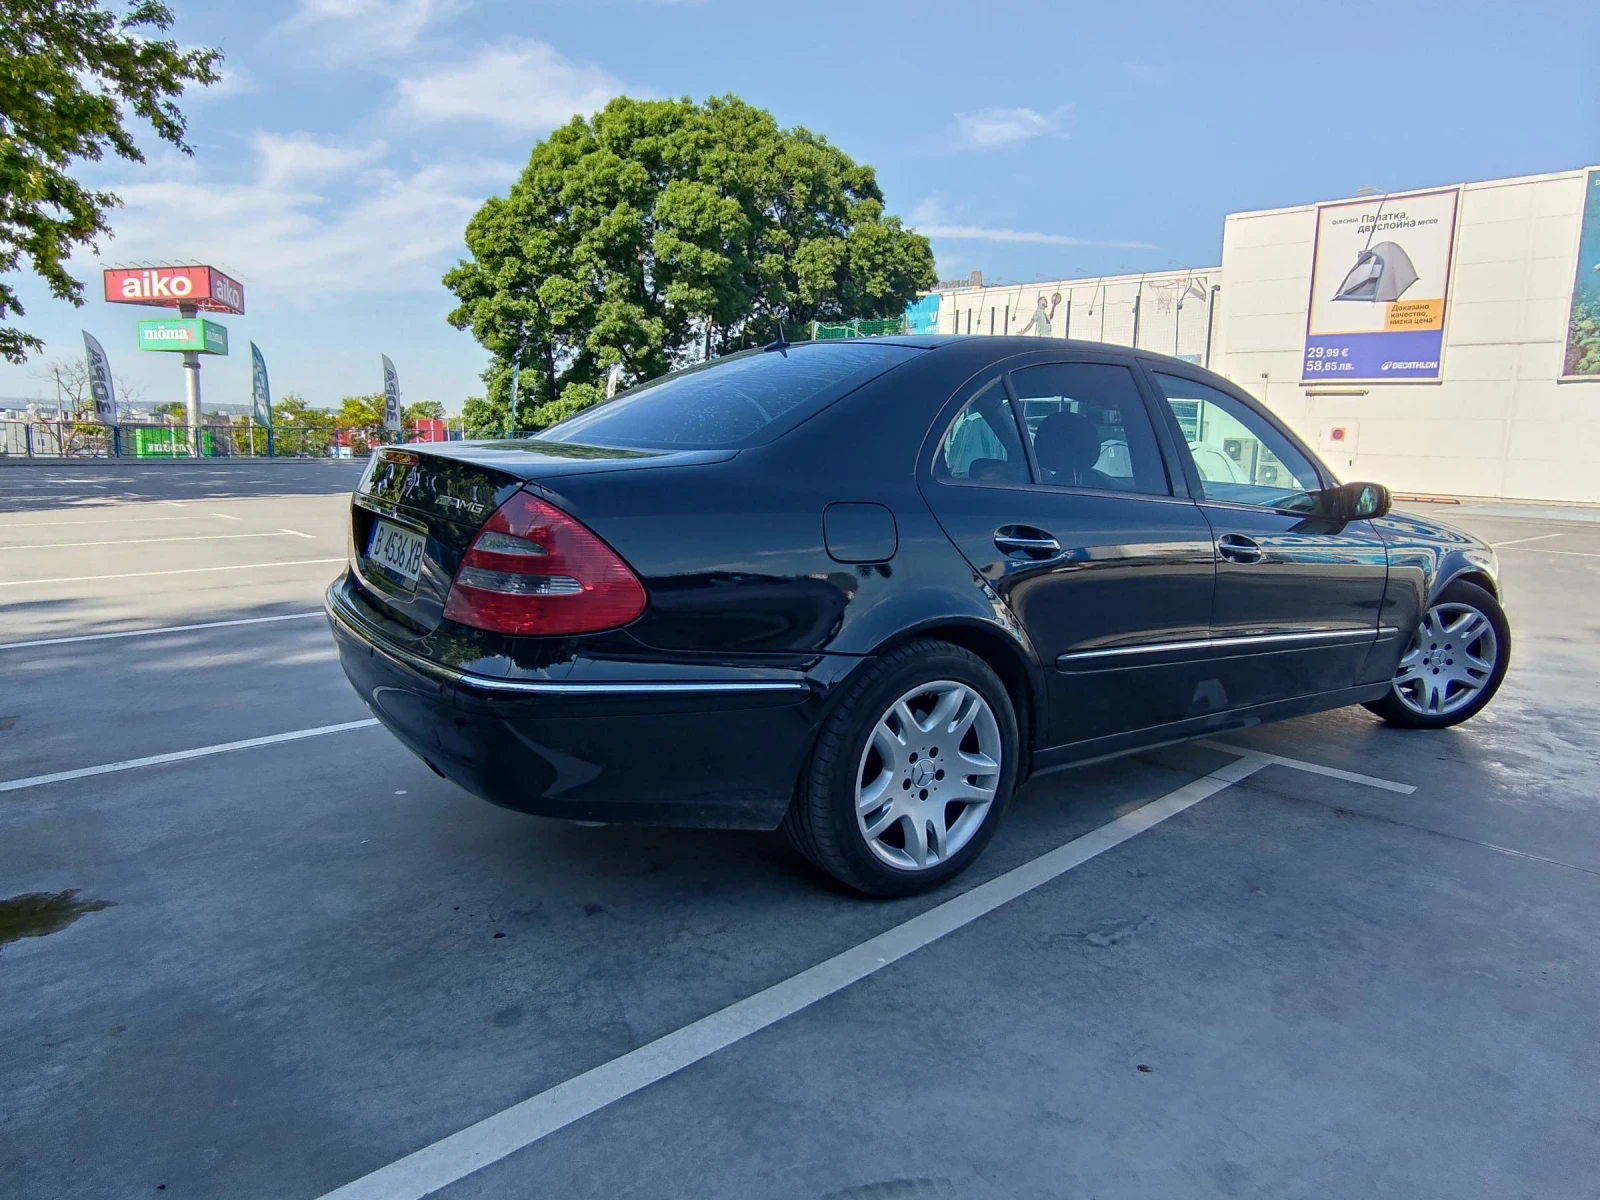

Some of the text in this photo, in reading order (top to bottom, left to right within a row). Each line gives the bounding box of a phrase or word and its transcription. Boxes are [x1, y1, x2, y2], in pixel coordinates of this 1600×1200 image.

[1361, 211, 1410, 224] Палатка,
[1357, 219, 1416, 234] двуслойна
[122, 271, 192, 298] aiko
[216, 278, 240, 308] aiko
[1391, 304, 1430, 312] Доказано
[1307, 347, 1349, 359] 29,99 €
[1306, 361, 1355, 373] 58,65 лв.
[1392, 361, 1438, 369] DECATHLON
[442, 495, 484, 514] AMG
[374, 527, 423, 575] B 4536 XB
